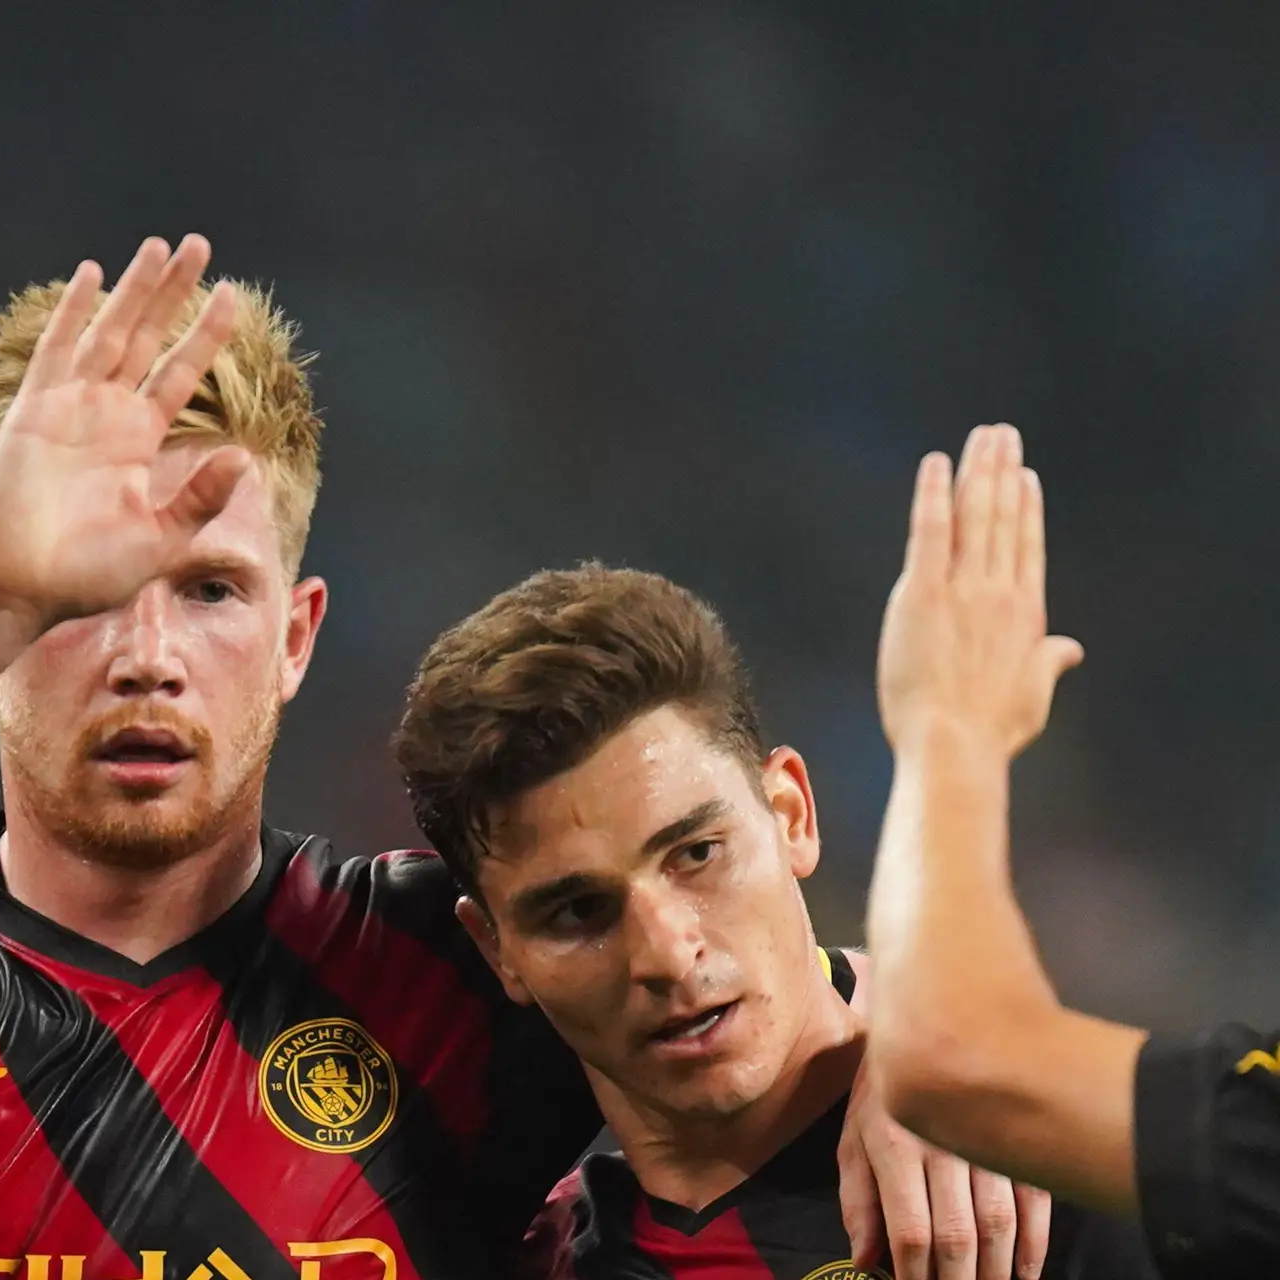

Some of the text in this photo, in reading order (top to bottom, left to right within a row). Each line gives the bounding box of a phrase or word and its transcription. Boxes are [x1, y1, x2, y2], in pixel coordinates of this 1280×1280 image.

[274, 1028, 380, 1070] MANCHESTER
[271, 1082, 283, 1091] 18
[316, 1129, 355, 1142] CITY
